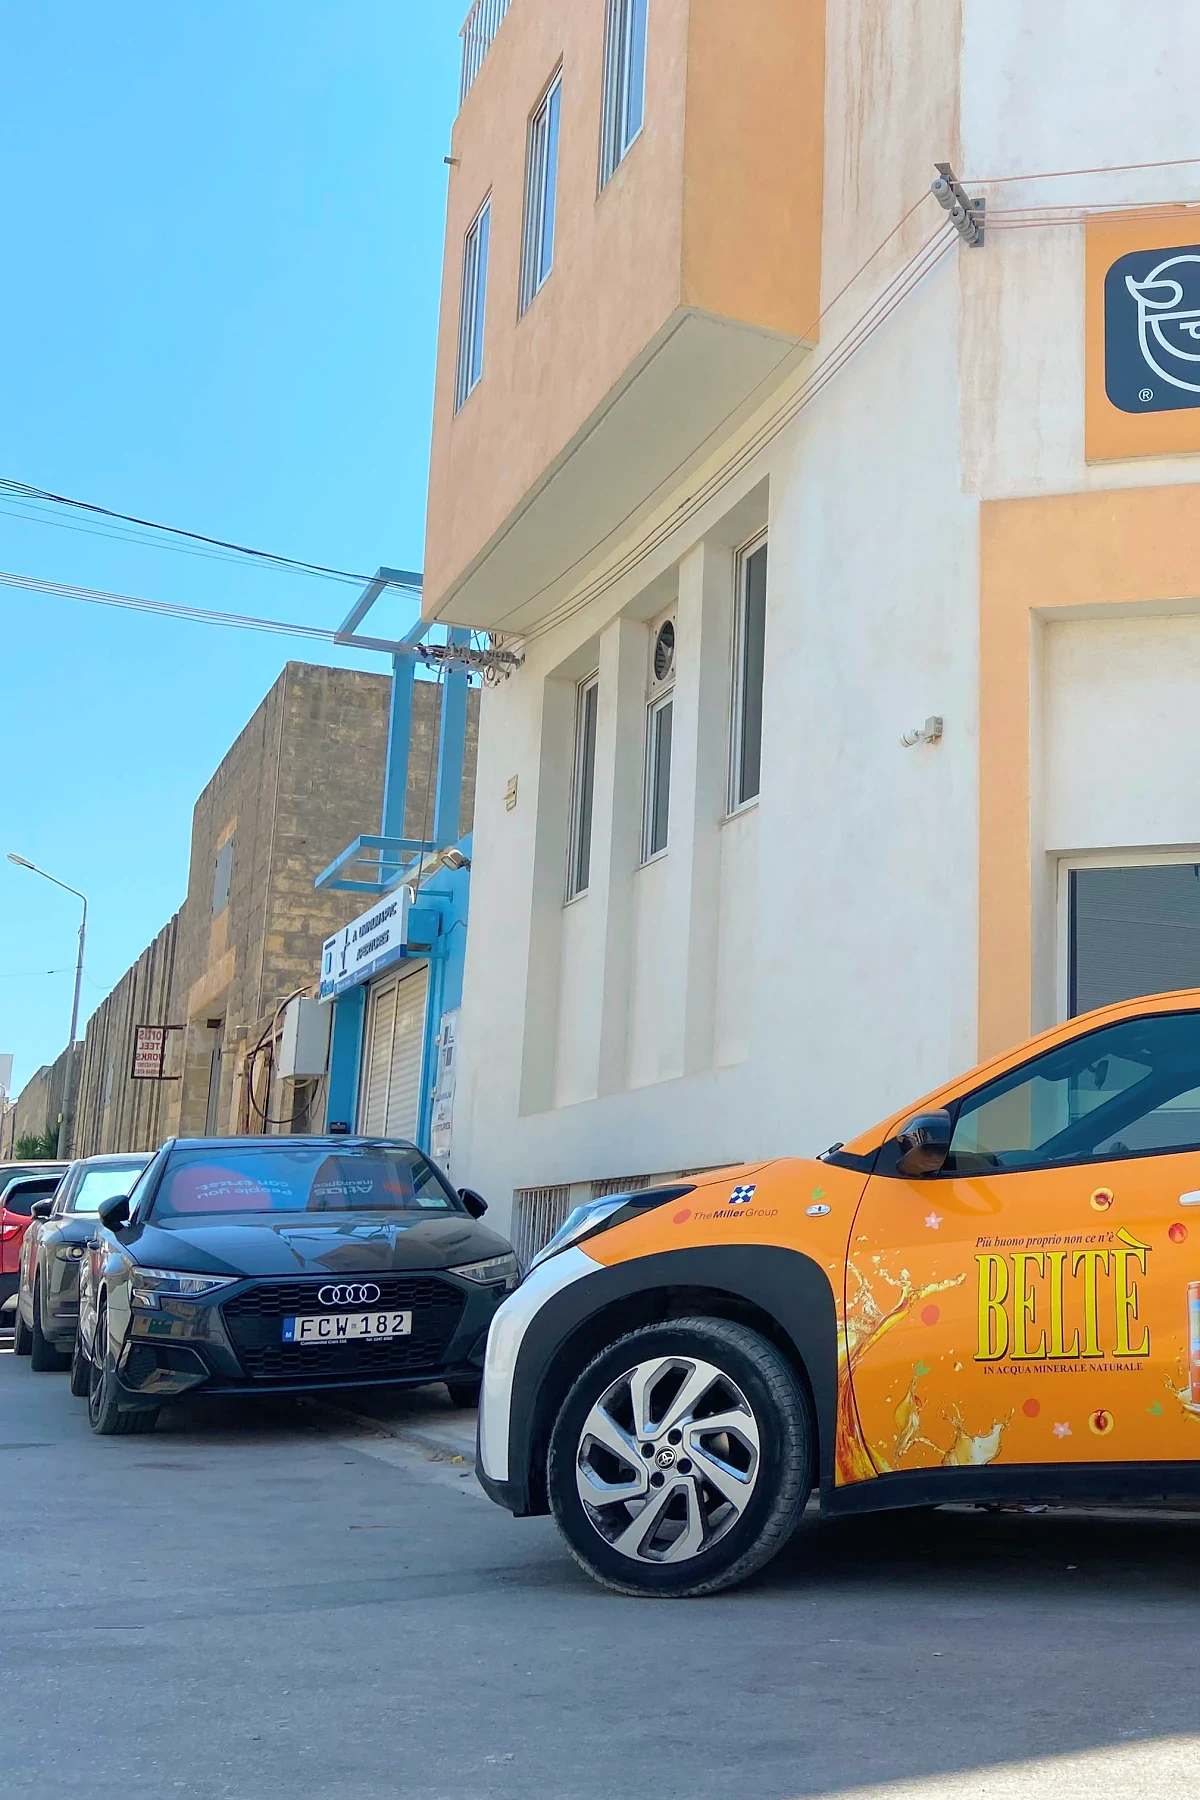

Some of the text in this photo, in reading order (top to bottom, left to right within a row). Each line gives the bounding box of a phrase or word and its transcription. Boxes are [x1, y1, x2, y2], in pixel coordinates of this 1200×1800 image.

[197, 1185, 292, 1199] People you
[314, 1185, 373, 1196] Atlas
[975, 1236, 992, 1248] Più
[994, 1236, 1024, 1247] buono
[1025, 1235, 1062, 1248] proprio
[1063, 1235, 1083, 1244] non
[1085, 1235, 1096, 1243] ce
[973, 1226, 1152, 1361] BELTÈ
[300, 1314, 405, 1339] FCW 182
[983, 1362, 1143, 1375] IN ACQUA MINERALE NATURALE
